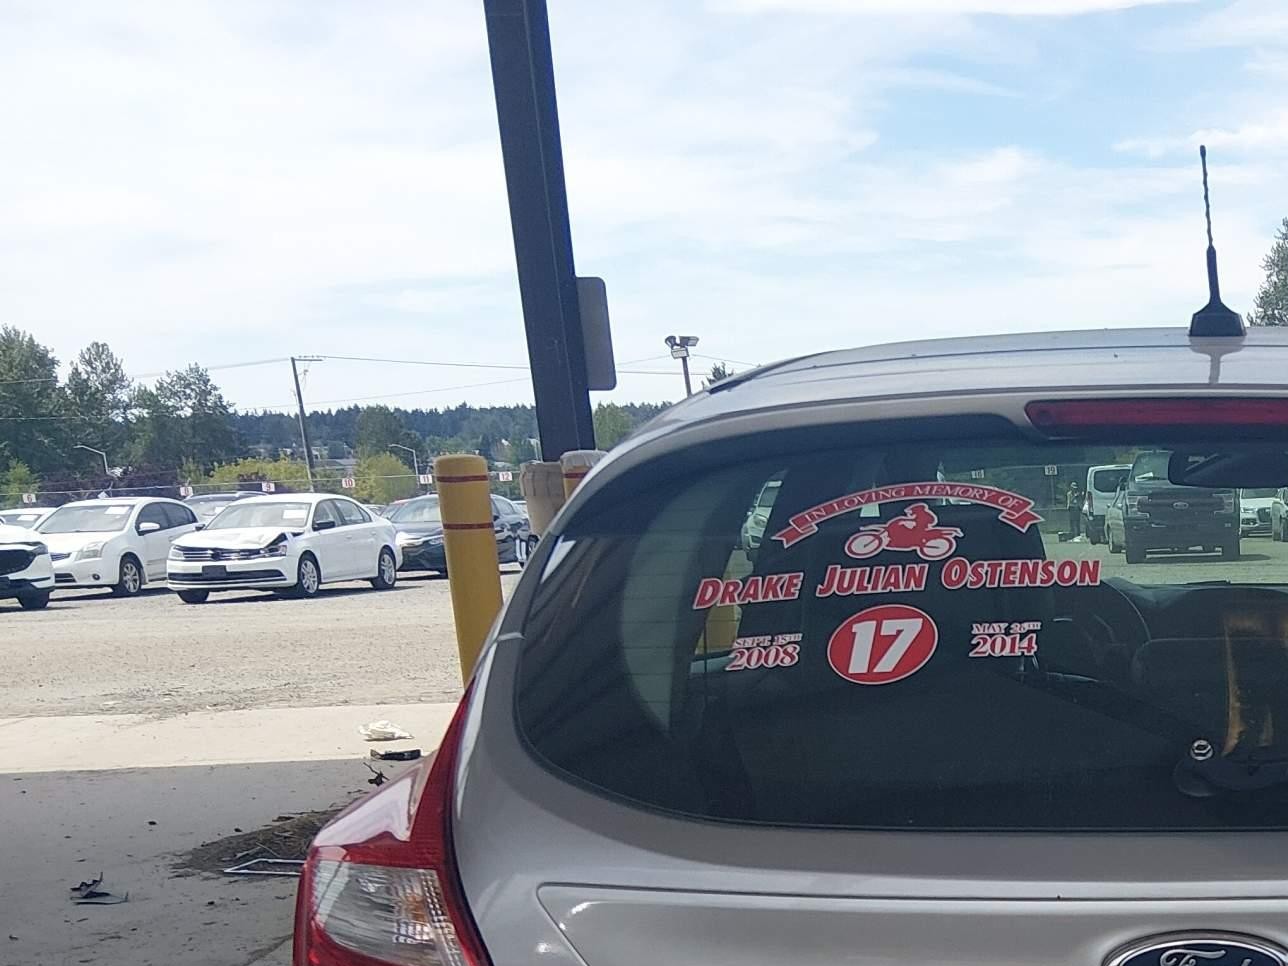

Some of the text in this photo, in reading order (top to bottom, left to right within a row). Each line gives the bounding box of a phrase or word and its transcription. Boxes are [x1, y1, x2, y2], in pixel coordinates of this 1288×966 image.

[804, 485, 1024, 522] IN LOVING MEMORY OF
[693, 558, 1101, 609] DRAKE JULIAN OSTENSON
[971, 623, 1008, 634] MAY
[725, 644, 800, 671] 2008
[847, 617, 924, 674] 17
[969, 633, 1037, 657] 2014
